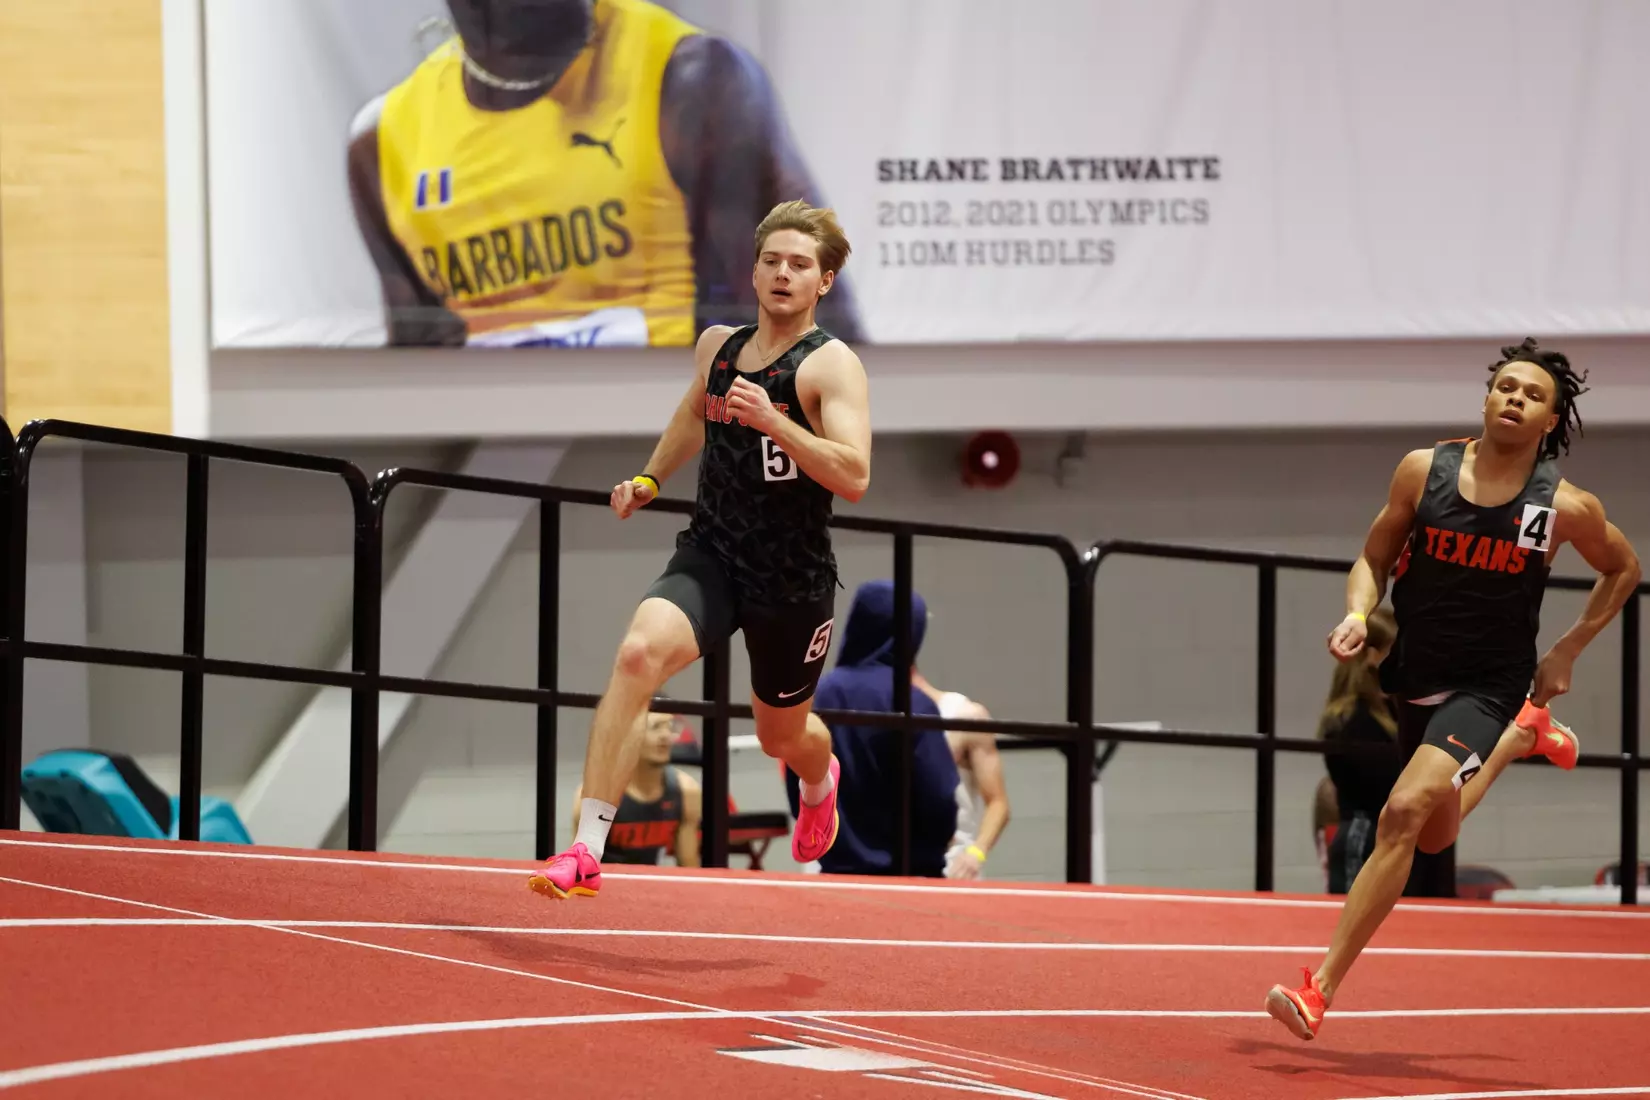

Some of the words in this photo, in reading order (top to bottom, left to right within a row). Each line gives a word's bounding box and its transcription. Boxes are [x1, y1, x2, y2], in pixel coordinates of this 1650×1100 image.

[878, 159, 989, 181] SHANE
[1000, 158, 1220, 181] BRATHWAITE
[968, 200, 1039, 226] 2021
[1047, 199, 1210, 225] OLYMPICS
[423, 200, 634, 298] BARBADOS
[881, 241, 957, 266] 110M
[965, 240, 1116, 266] HURDLES
[767, 440, 791, 477] 5
[1523, 509, 1549, 548] 4
[1425, 527, 1530, 574] TEXANS
[810, 623, 831, 659] 5
